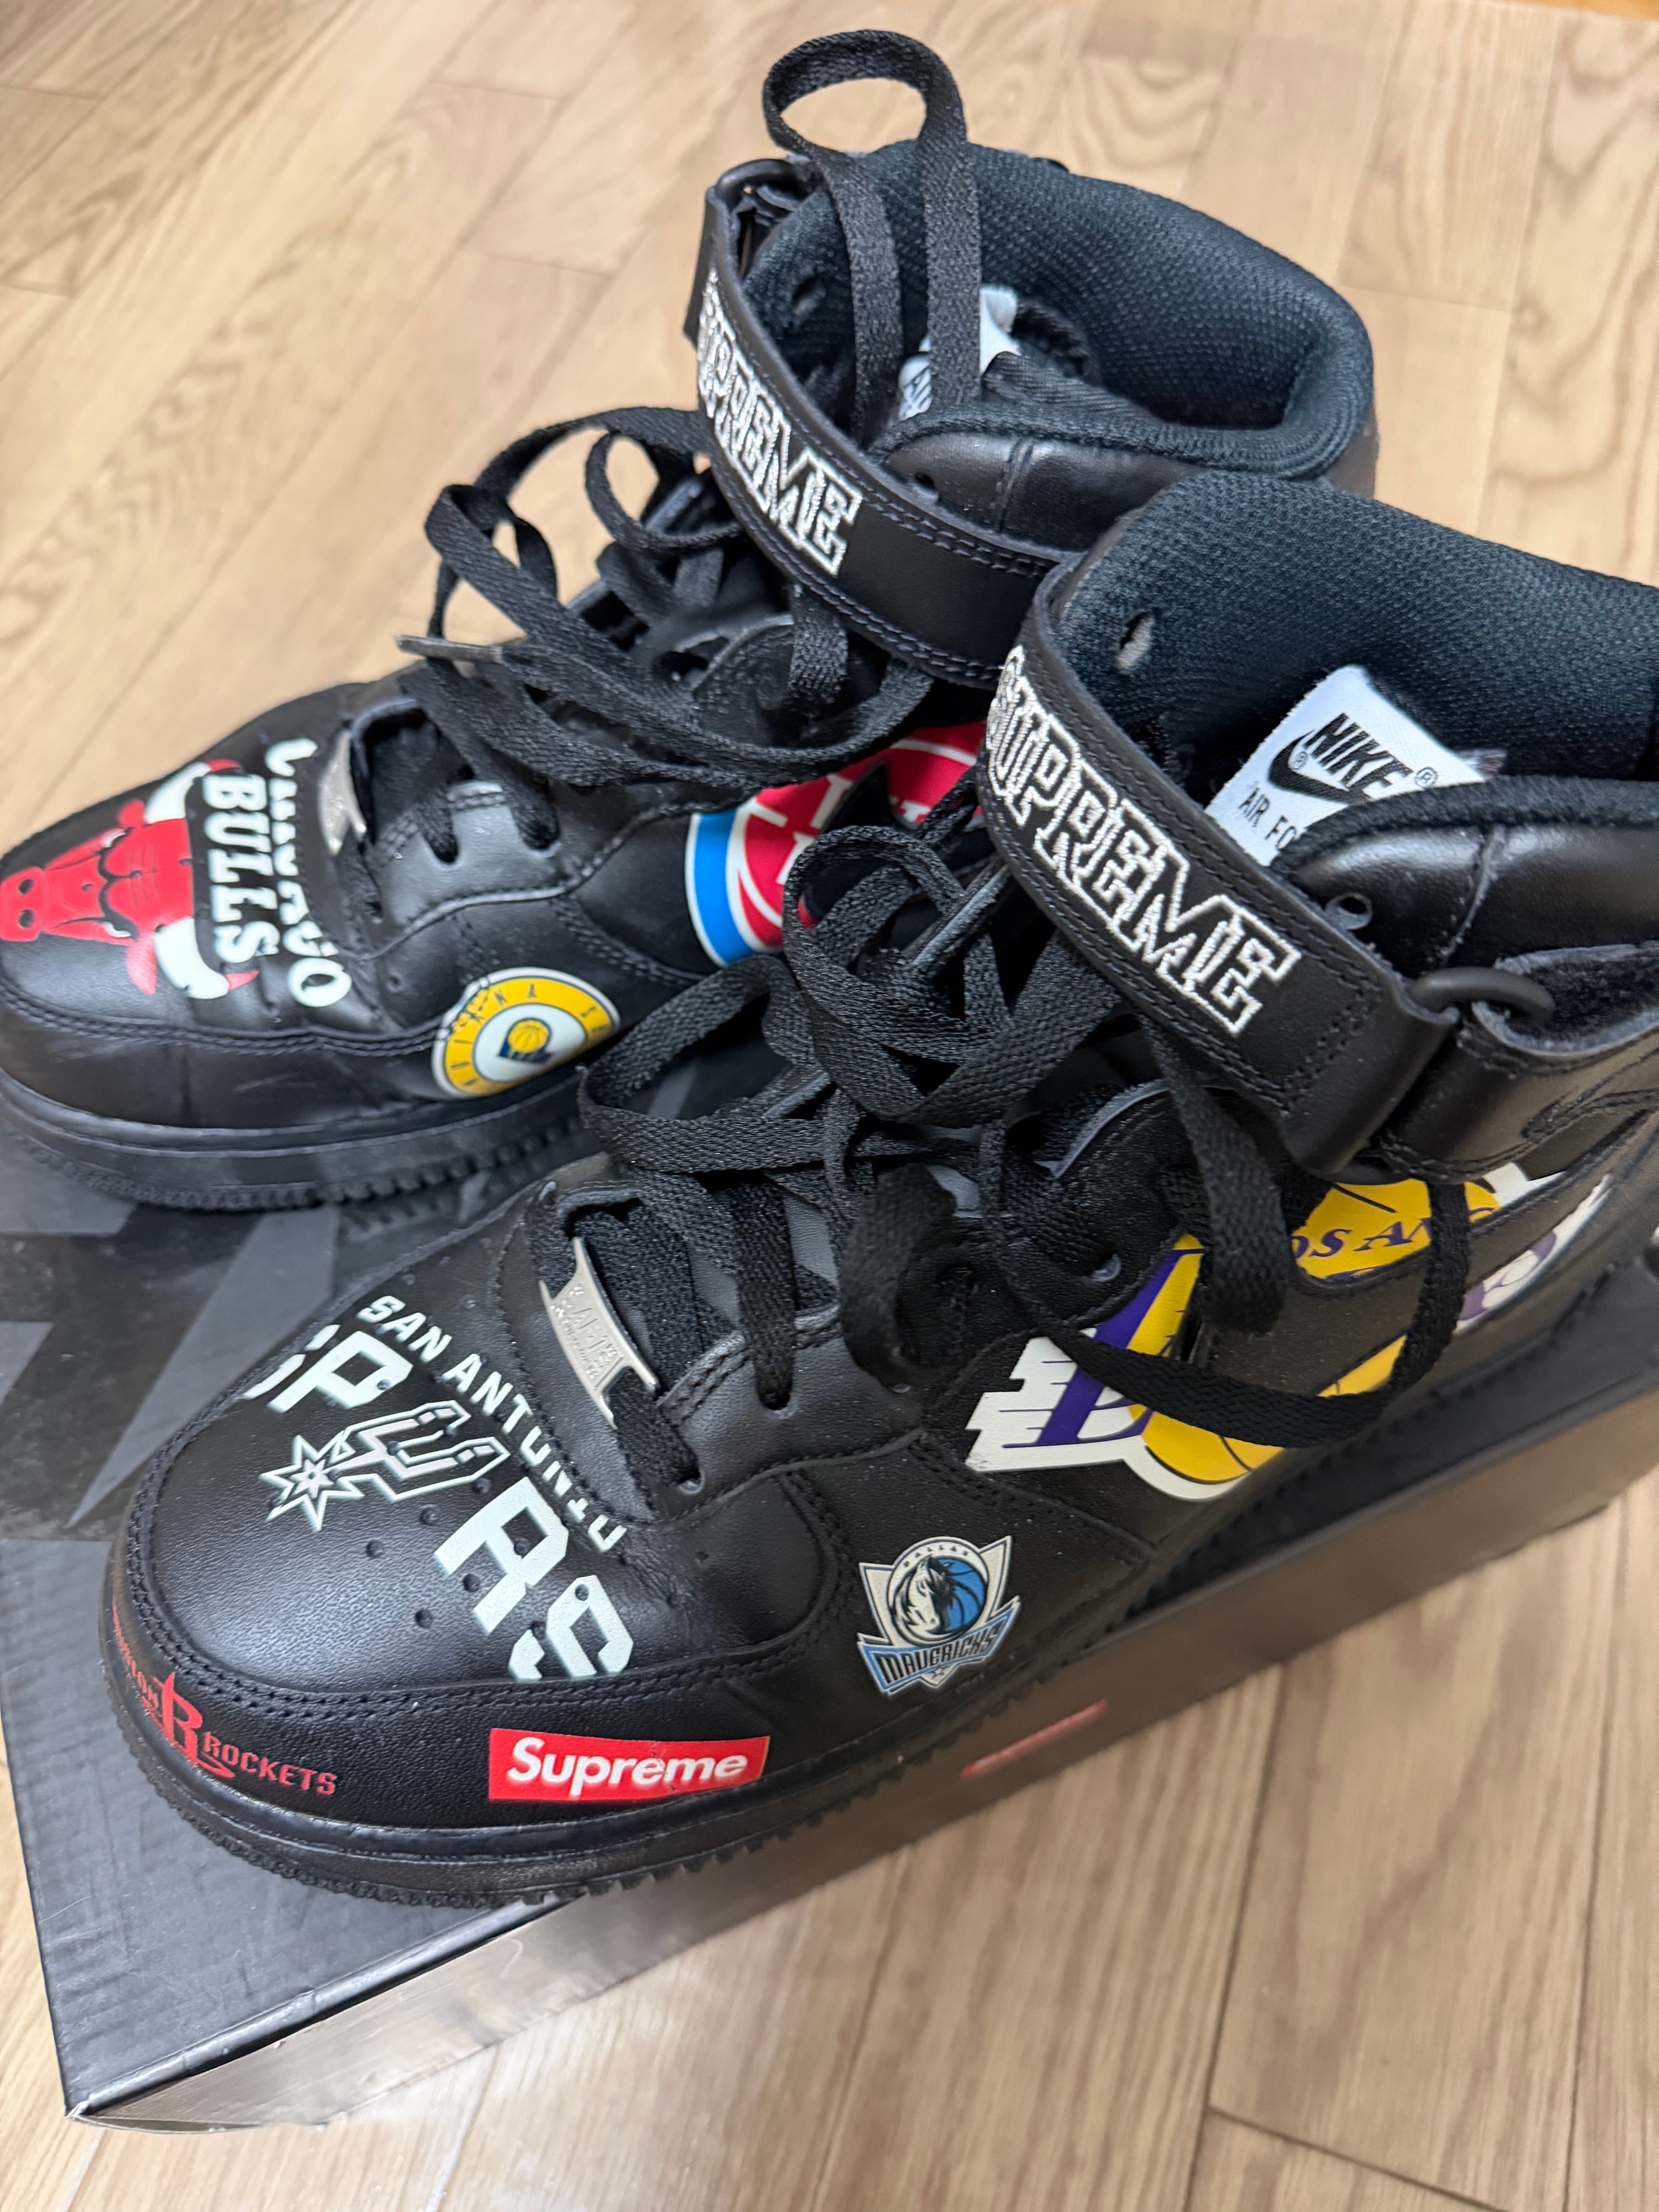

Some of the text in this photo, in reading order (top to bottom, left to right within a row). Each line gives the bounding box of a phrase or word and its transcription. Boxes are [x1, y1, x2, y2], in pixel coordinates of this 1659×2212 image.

[1239, 788, 1270, 828] AIR
[203, 774, 280, 963] BULLS
[356, 1295, 452, 1362] SAN
[203, 1732, 337, 1795] ROCKETS
[507, 1736, 747, 1796] Supreme
